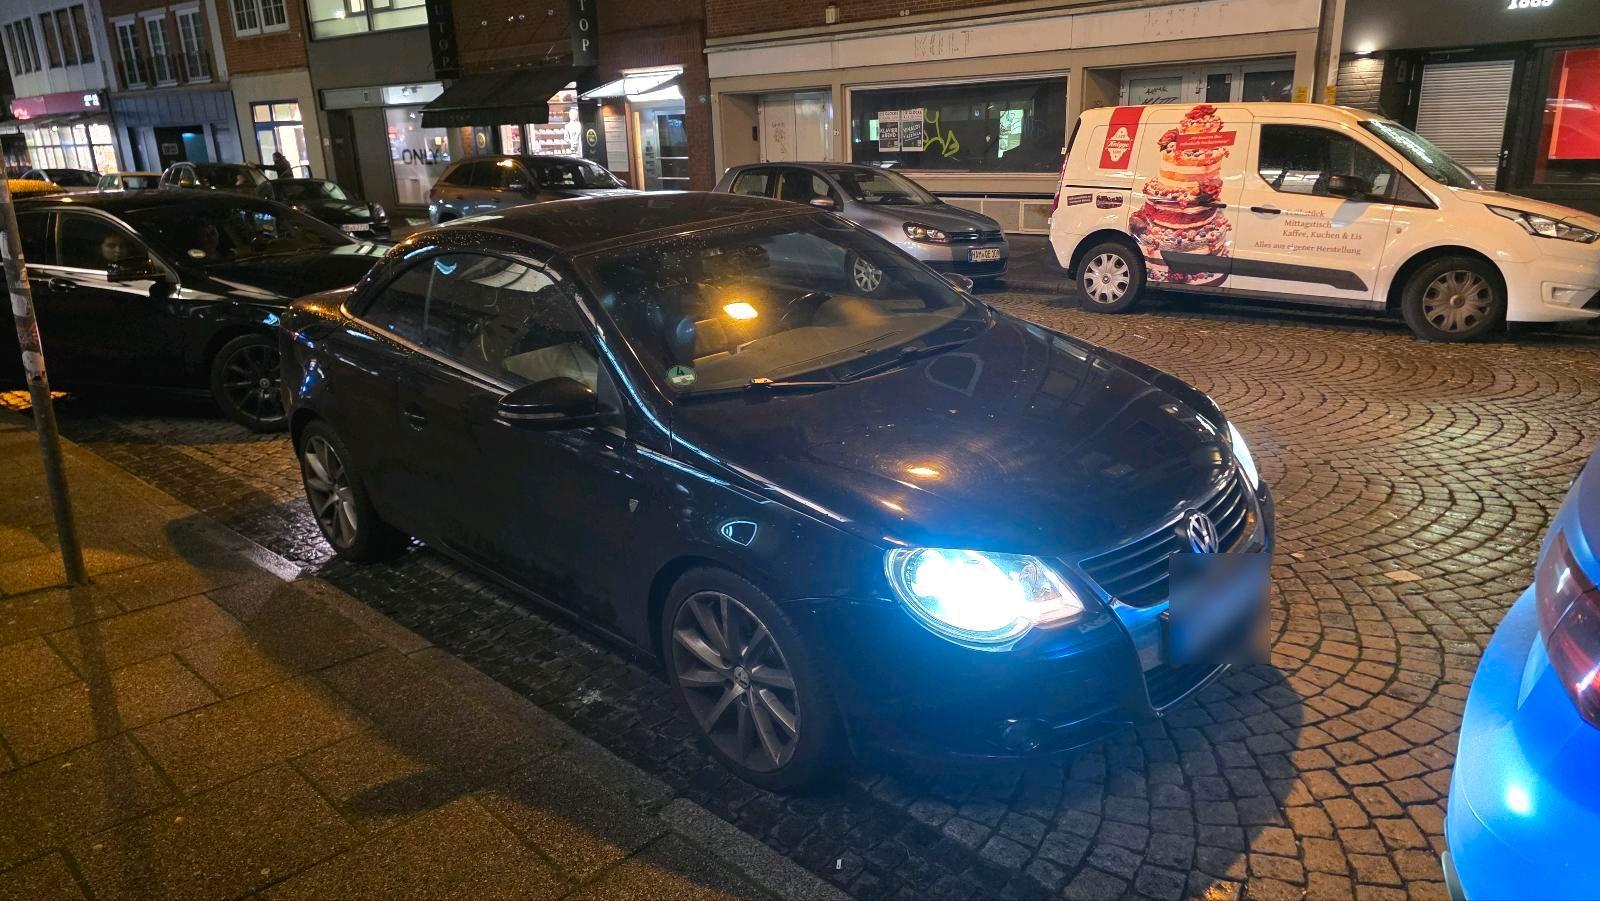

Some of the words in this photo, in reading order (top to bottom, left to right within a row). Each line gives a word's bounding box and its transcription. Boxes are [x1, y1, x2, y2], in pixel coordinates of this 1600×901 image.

[402, 148, 440, 165] ONLY
[1284, 219, 1332, 229] Mittagstisch
[1282, 229, 1309, 238] Kaffee,
[1310, 231, 1340, 239] Kuchen
[1342, 232, 1348, 240] &
[1287, 243, 1315, 251] eigener
[1316, 245, 1361, 255] Herstellung
